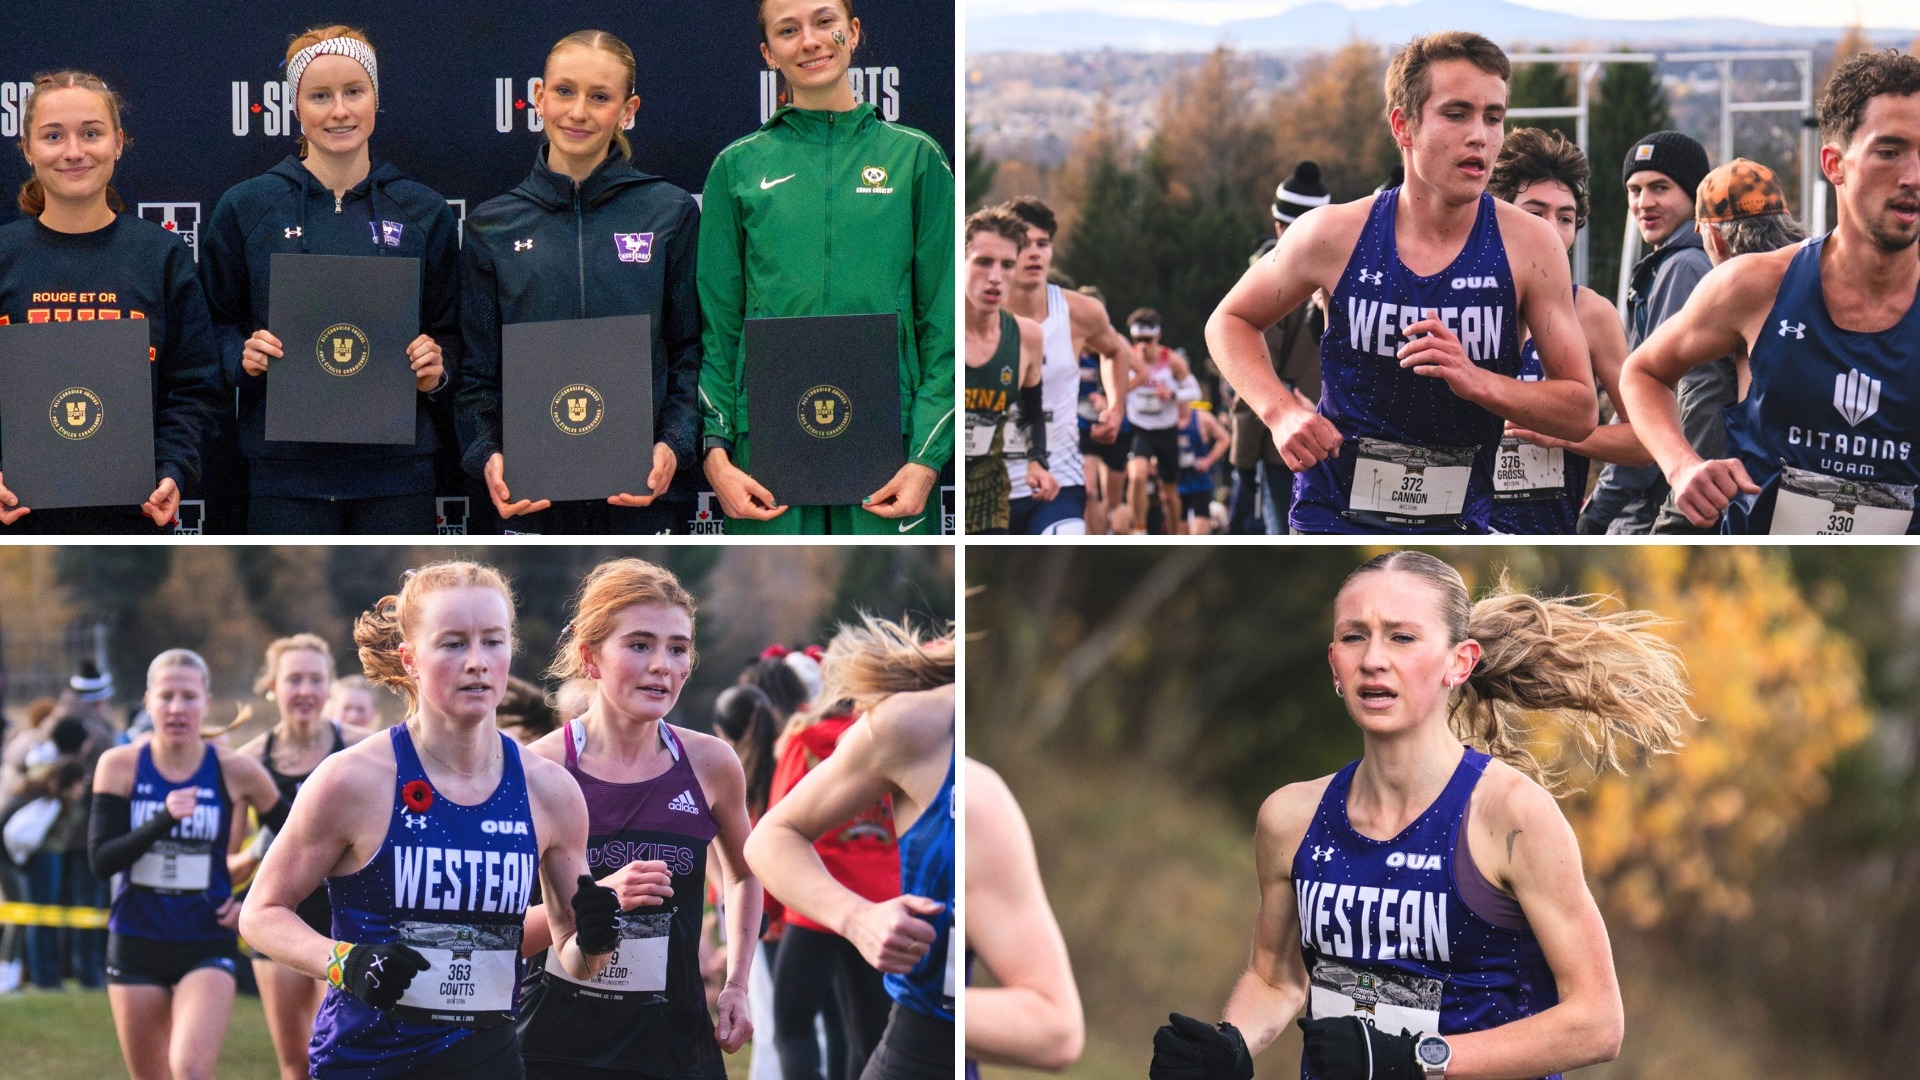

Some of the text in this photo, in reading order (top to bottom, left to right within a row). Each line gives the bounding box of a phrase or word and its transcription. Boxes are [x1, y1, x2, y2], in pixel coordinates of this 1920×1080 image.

[1451, 276, 1499, 290] OUA
[32, 293, 117, 302] ROUGE ET OR
[1788, 425, 1912, 461] CITADINS
[1500, 456, 1520, 468] 376
[1820, 458, 1875, 476] UQAM
[1497, 470, 1525, 480] GROSSI
[1401, 476, 1424, 492] 372
[1392, 490, 1428, 504] CANNON
[1827, 514, 1854, 533] 330
[668, 801, 699, 815] adidas
[481, 820, 528, 836] OUA
[586, 841, 694, 876] USKIES
[1386, 852, 1442, 870] OUA
[394, 845, 535, 915] WESTERN
[1296, 878, 1451, 962] WESTERN
[448, 964, 472, 981] 363
[440, 982, 475, 996] COUTTS
